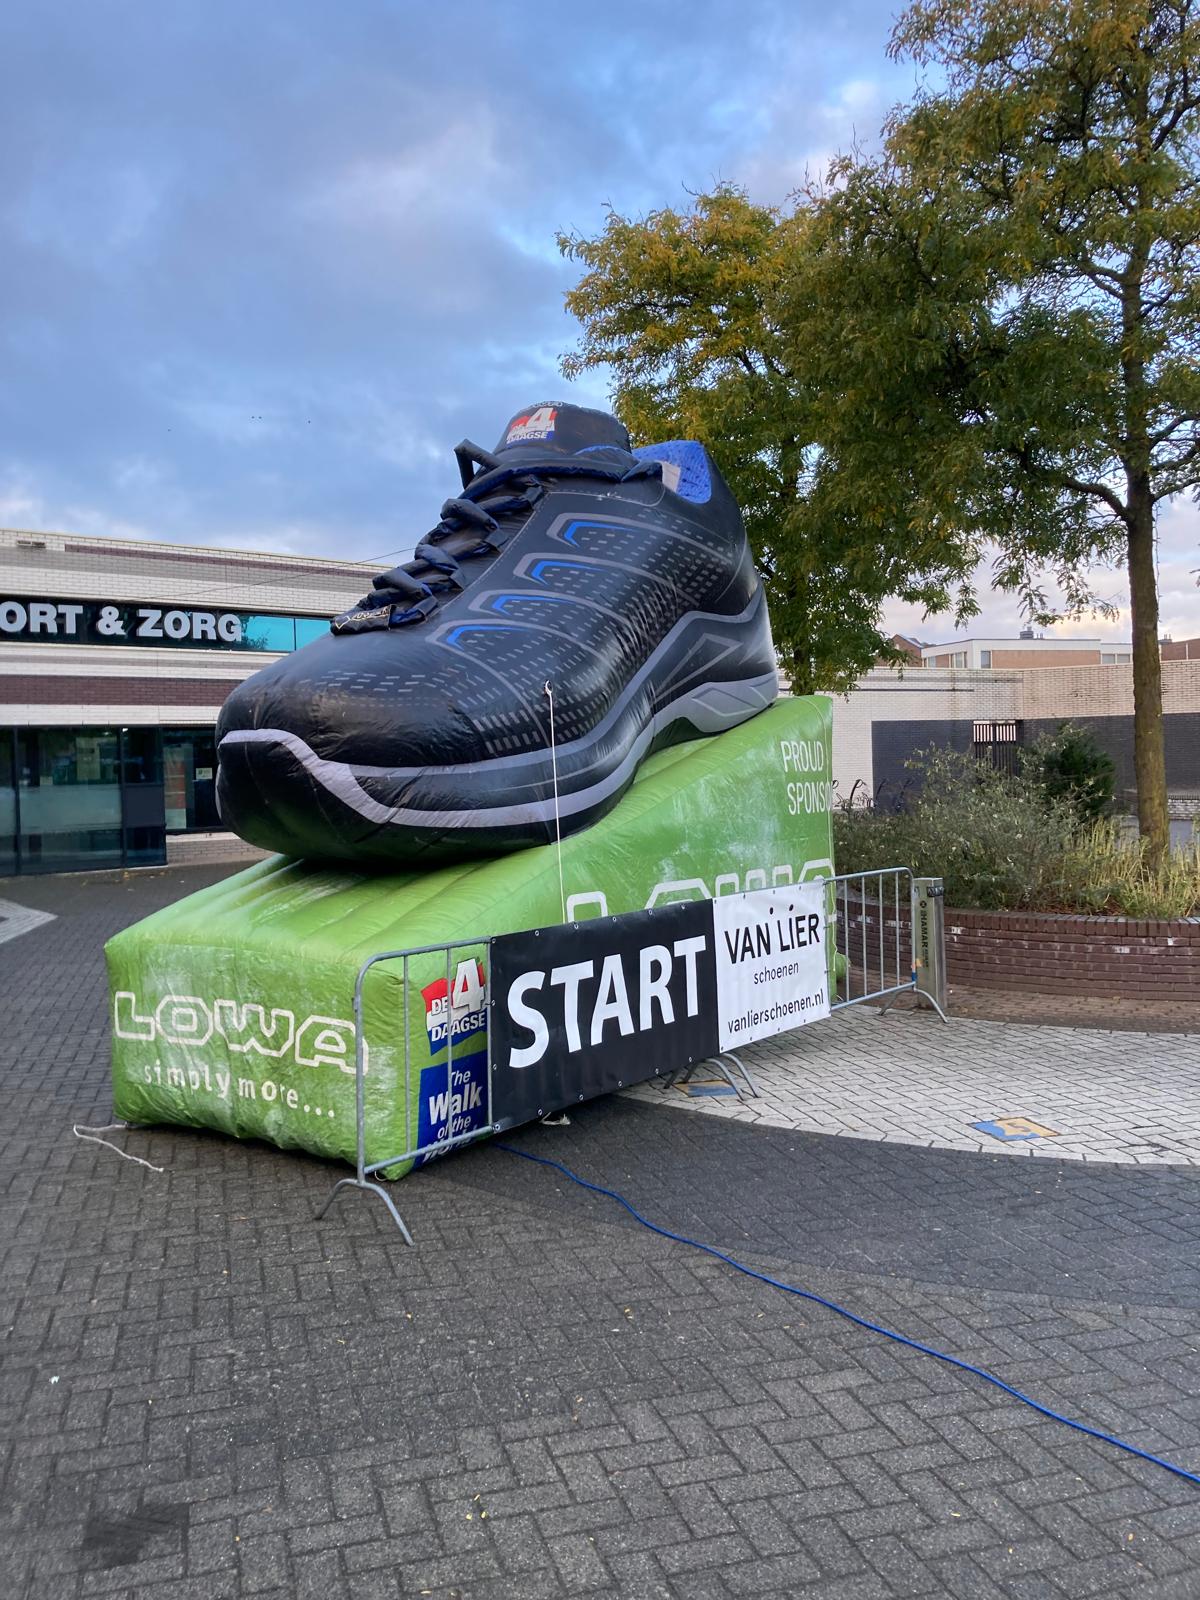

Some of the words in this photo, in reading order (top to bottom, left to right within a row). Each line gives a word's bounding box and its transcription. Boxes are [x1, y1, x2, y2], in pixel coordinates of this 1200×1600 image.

[526, 407, 555, 432] 4
[97, 605, 126, 635] &
[136, 608, 242, 642] ZORG
[781, 740, 824, 772] PROUD
[787, 781, 833, 815] SPONSO
[724, 922, 771, 965] VAN
[777, 913, 820, 952] LIER
[453, 958, 486, 1013] 4
[753, 962, 799, 985] schoenen
[431, 996, 449, 1016] DE
[507, 935, 706, 1069] START
[728, 988, 824, 1033] vanlierschoenen.nl
[431, 1012, 486, 1042] DAAGSE
[144, 1059, 230, 1099] simply
[429, 1082, 482, 1125] Walk
